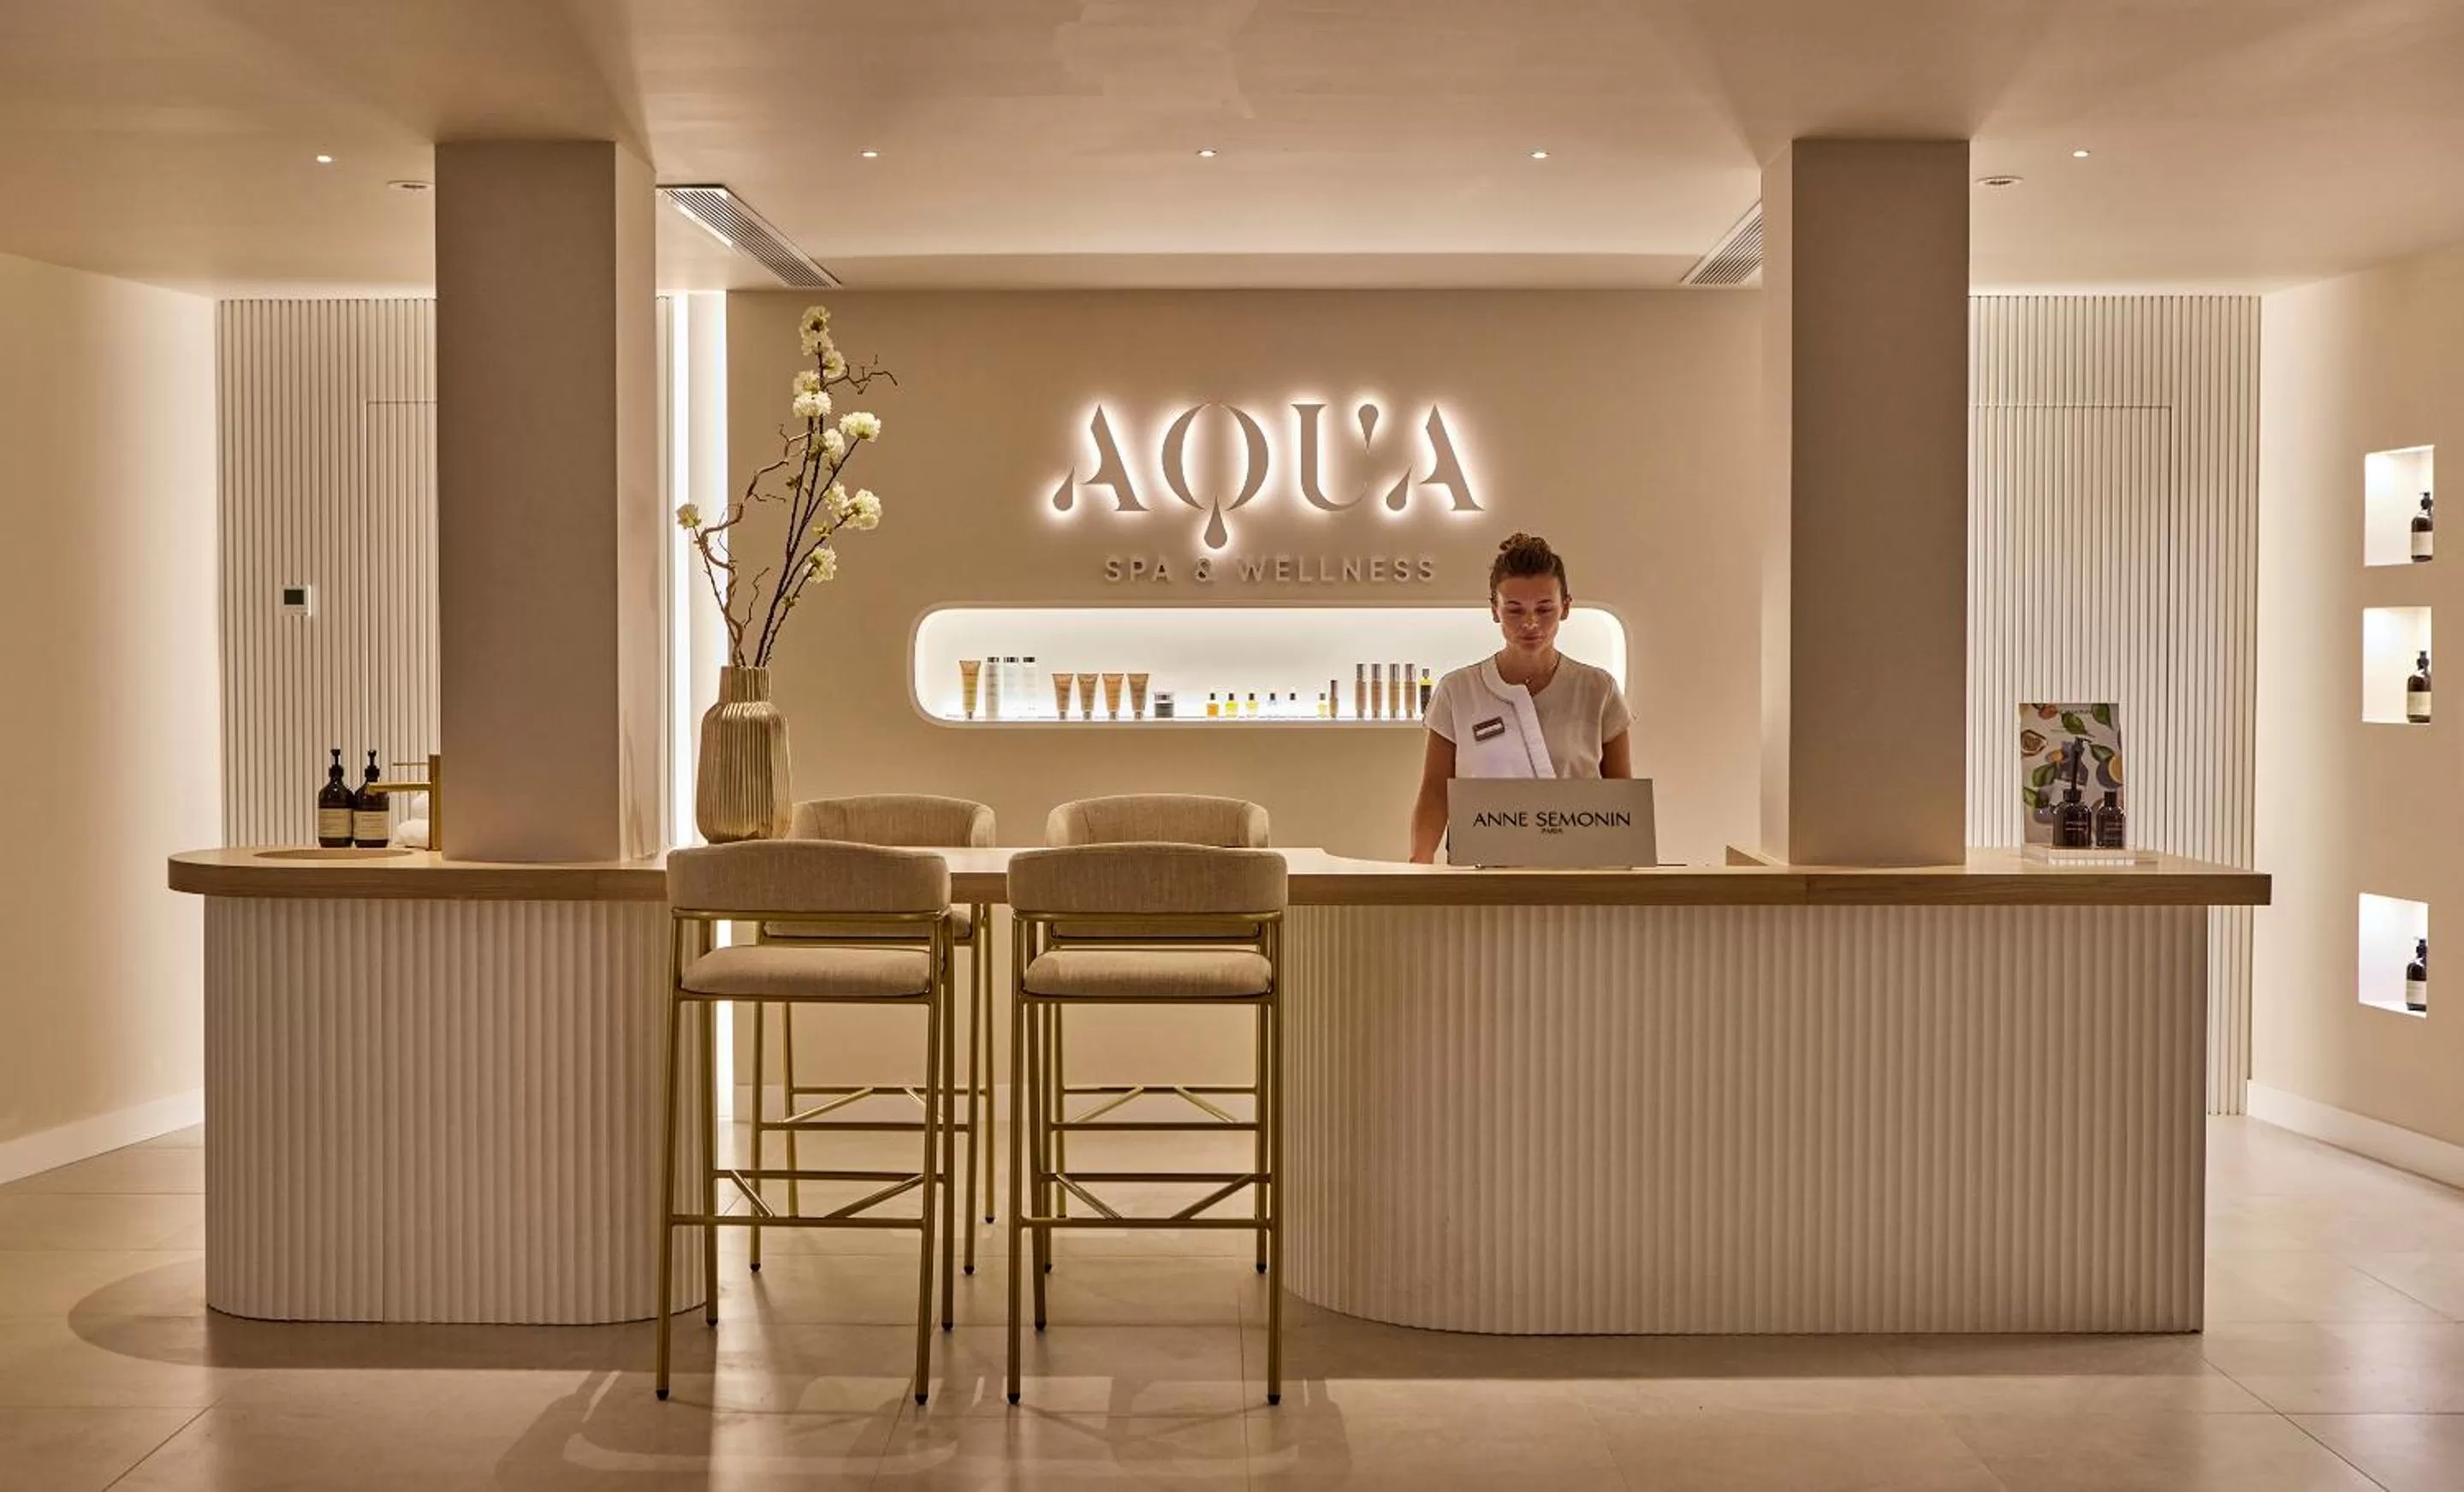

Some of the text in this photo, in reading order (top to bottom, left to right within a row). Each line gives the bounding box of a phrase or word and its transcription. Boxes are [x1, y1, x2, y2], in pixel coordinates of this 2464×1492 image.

[1104, 556, 1436, 583] SPA & WELLNESS
[1473, 812, 1630, 827] ANNE SEMONIN
